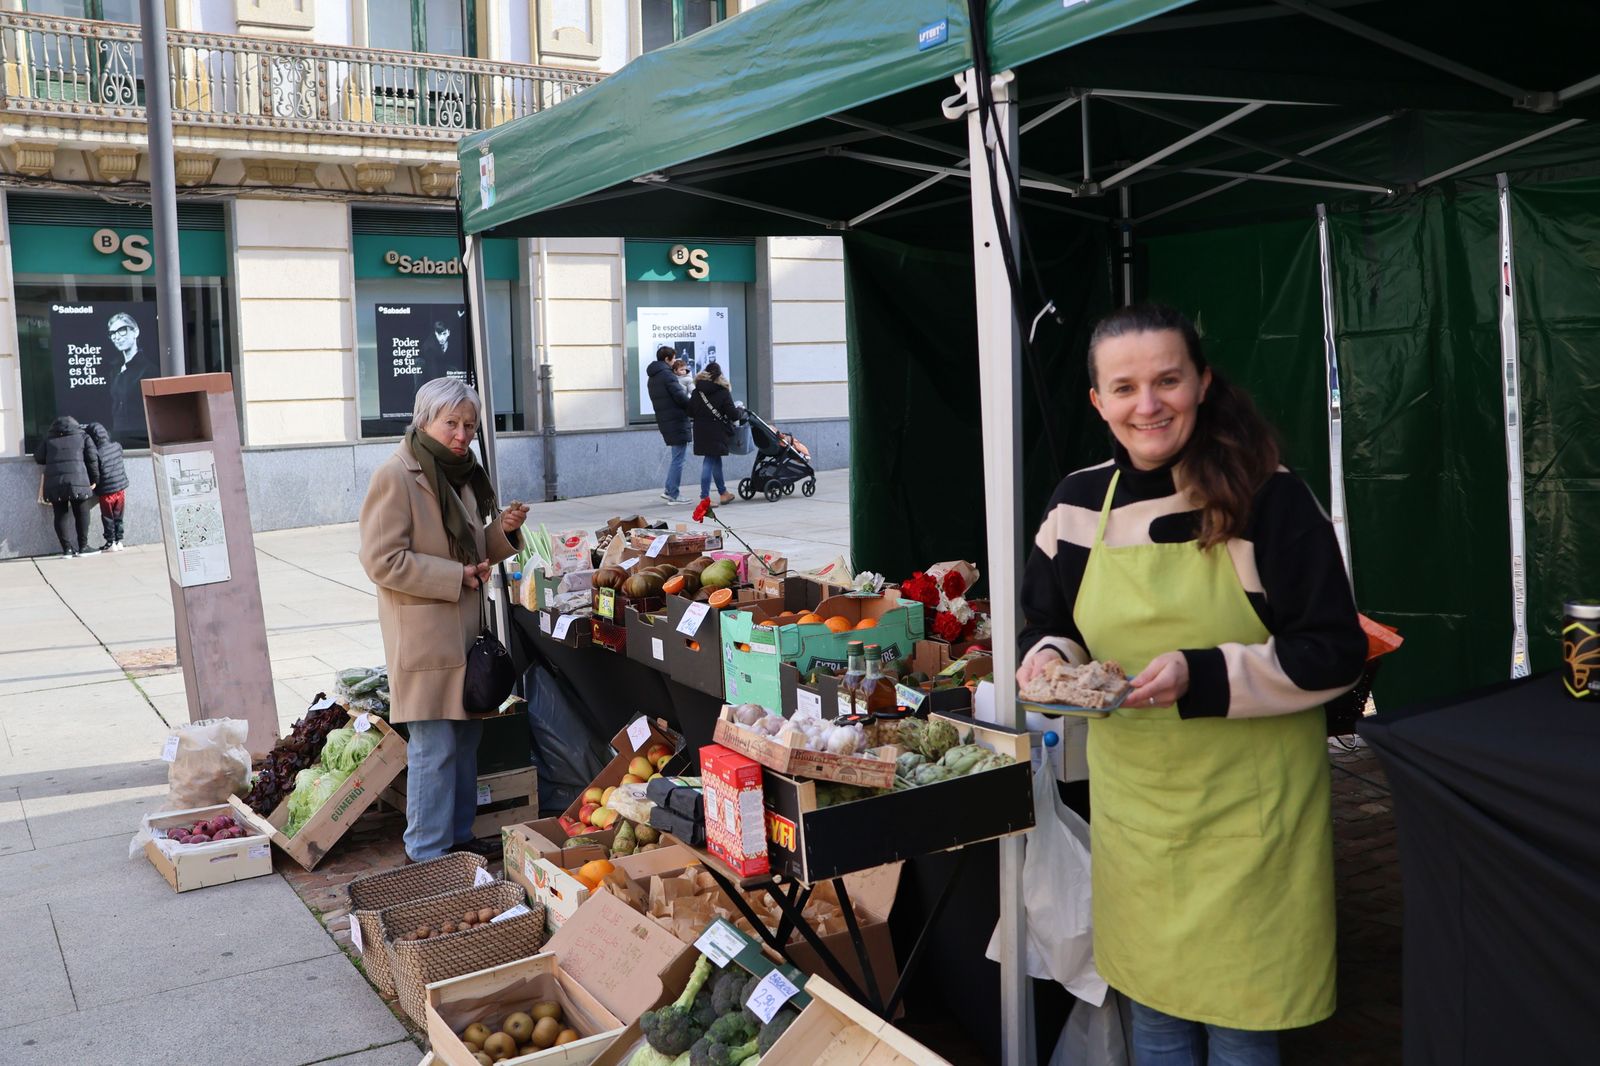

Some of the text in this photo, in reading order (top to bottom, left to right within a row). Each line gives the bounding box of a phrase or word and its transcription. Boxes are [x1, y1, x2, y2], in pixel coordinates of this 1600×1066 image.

[663, 323, 702, 333] especialista
[658, 331, 697, 340] especialista
[392, 338, 420, 347] Poder
[67, 344, 102, 355] Poder
[392, 347, 420, 359] elegir
[68, 354, 103, 367] elegir
[393, 356, 415, 366] es tu
[69, 365, 97, 376] es tu
[393, 365, 423, 377] poder.
[70, 375, 107, 388] poder.
[331, 786, 366, 823] GUMENDI
